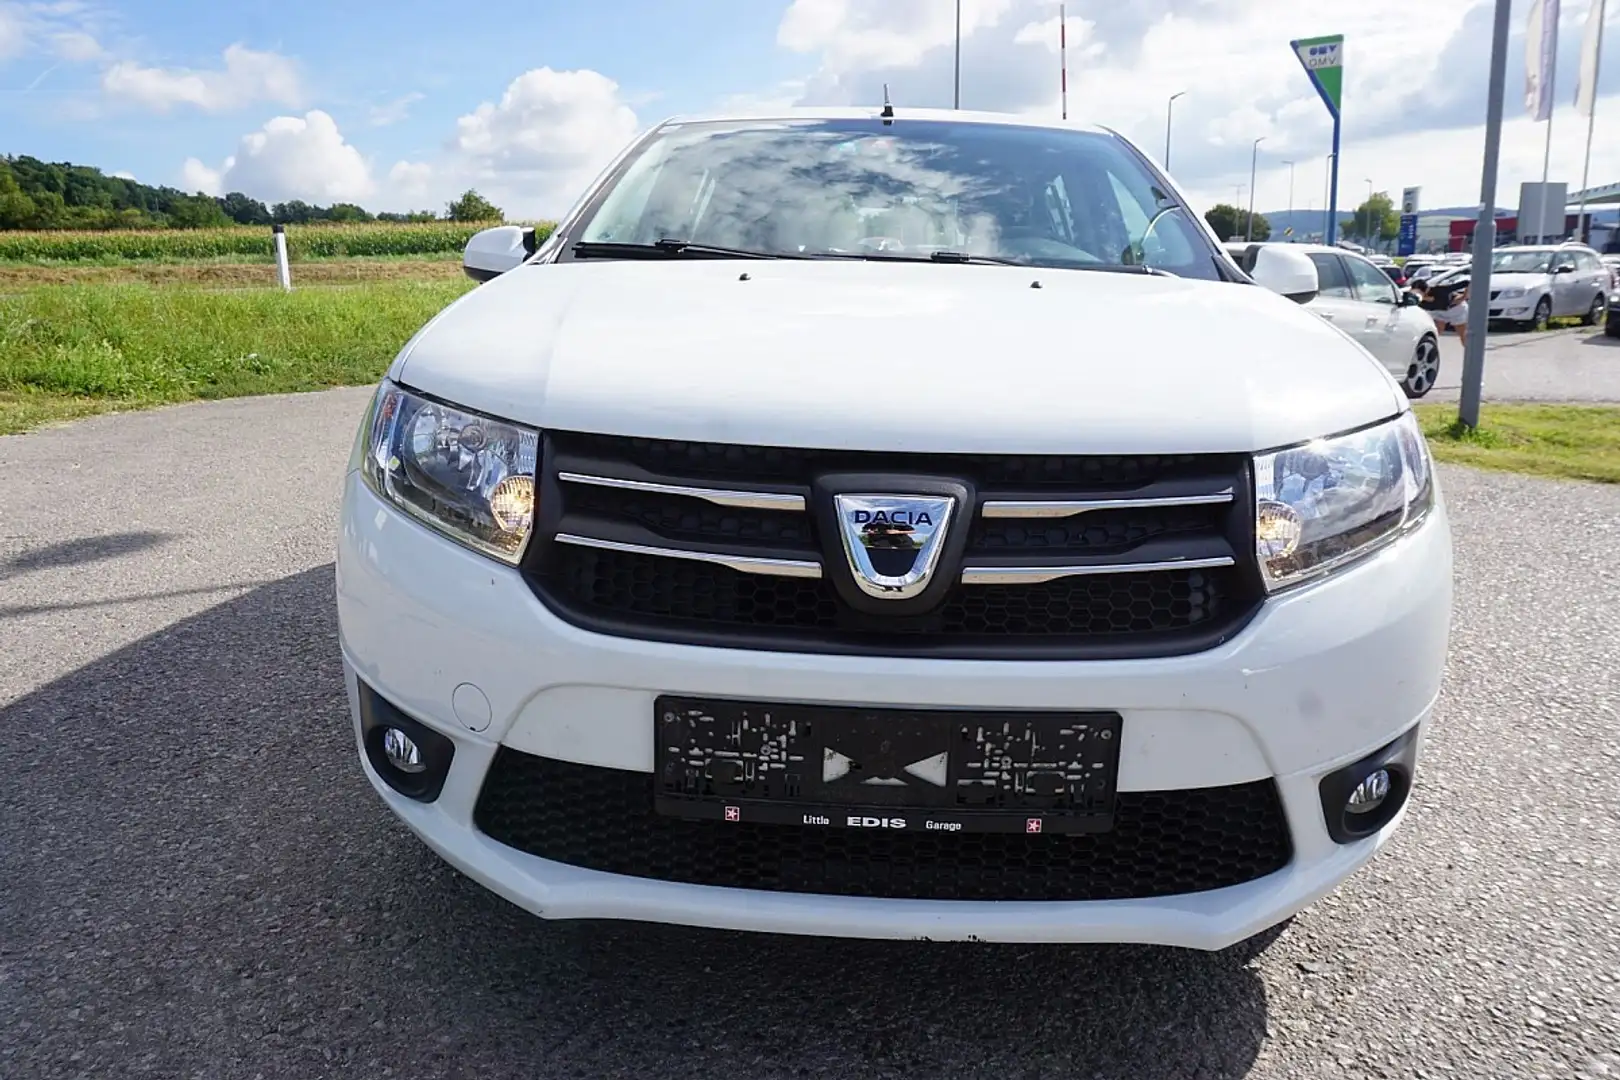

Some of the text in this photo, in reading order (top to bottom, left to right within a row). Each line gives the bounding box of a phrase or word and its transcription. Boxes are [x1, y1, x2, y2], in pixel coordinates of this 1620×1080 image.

[1309, 56, 1337, 68] OMV
[854, 510, 933, 526] DACIA
[803, 814, 962, 832] Little EDIS Garage
